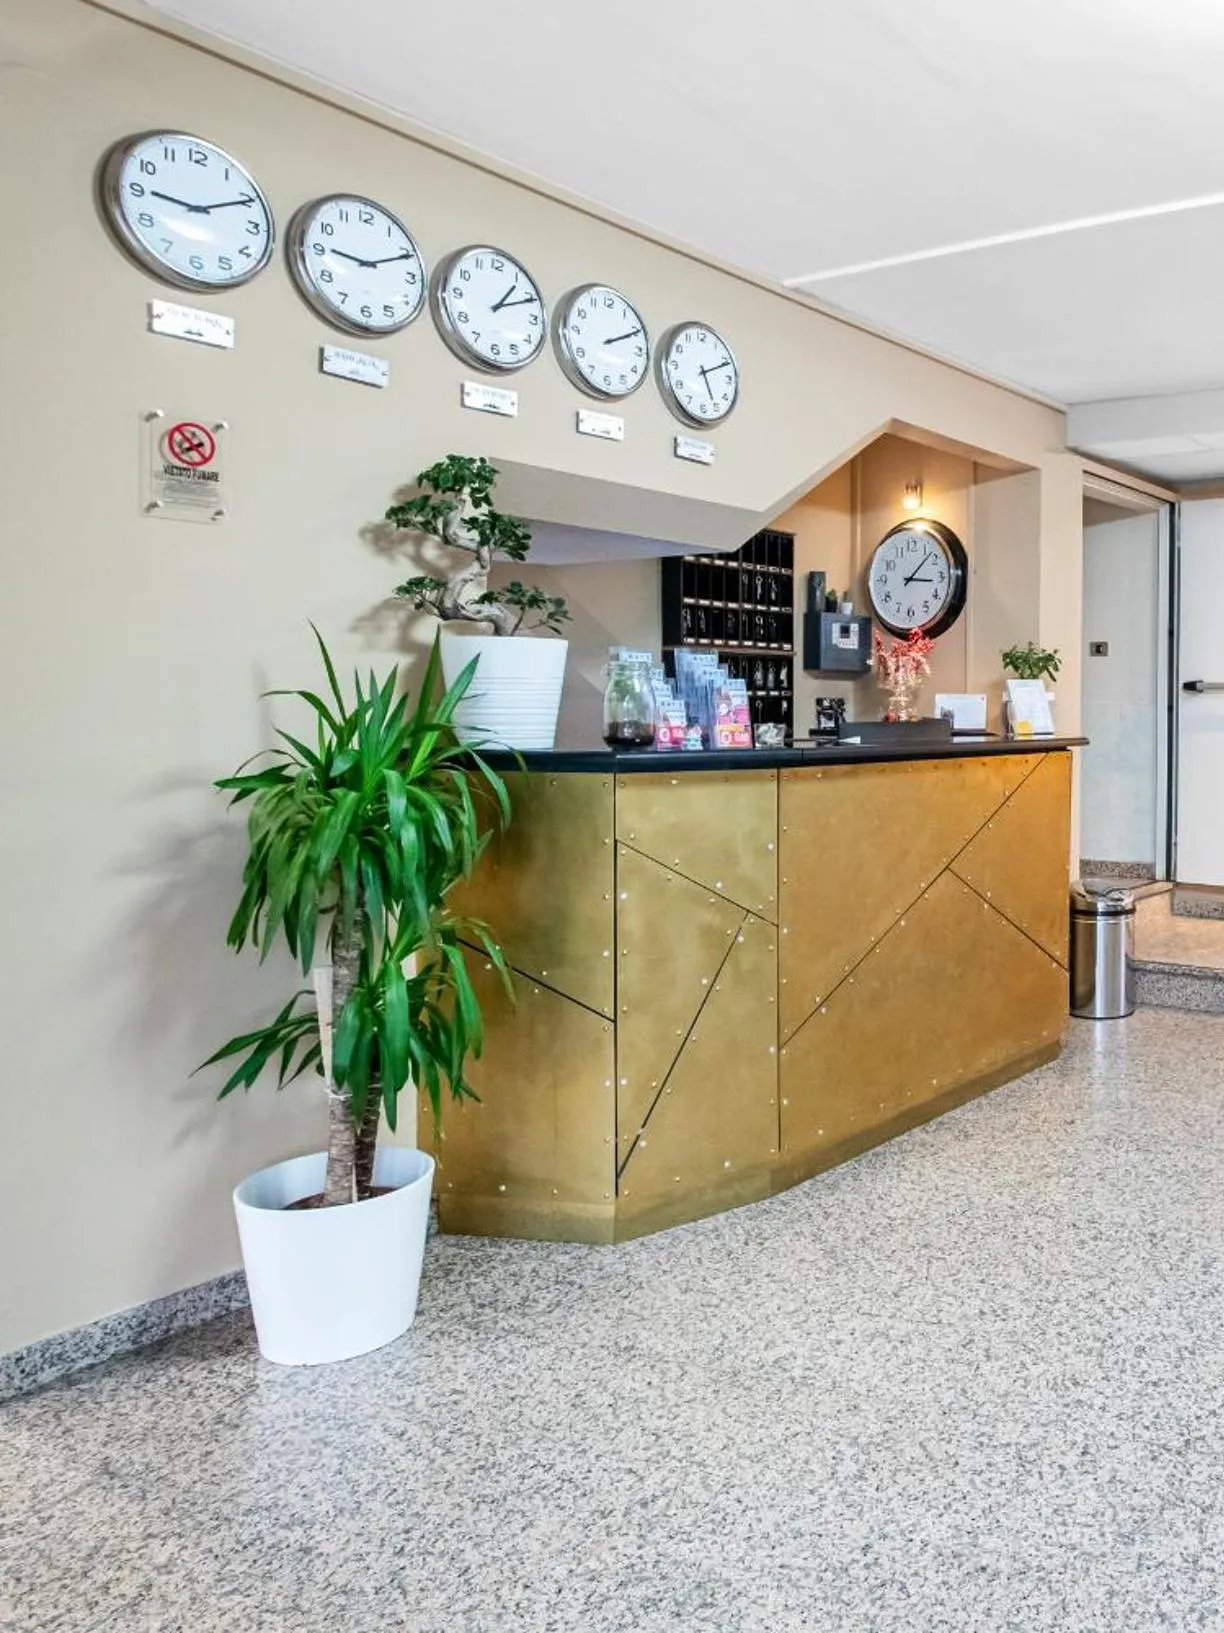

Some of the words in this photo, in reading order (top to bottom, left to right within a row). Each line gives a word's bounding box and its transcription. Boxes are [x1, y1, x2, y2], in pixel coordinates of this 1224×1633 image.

[164, 147, 176, 163] 11
[189, 148, 209, 167] 12
[140, 159, 156, 175] 10
[224, 167, 229, 181] 1
[129, 182, 145, 197] 9
[138, 213, 154, 228] 8
[339, 209, 348, 223] 11
[359, 210, 374, 226] 12
[246, 220, 260, 236] 3
[321, 221, 334, 236] 10
[160, 238, 173, 253] 7
[313, 243, 325, 257] 9
[238, 246, 252, 259] 4
[189, 255, 204, 269] 6
[218, 255, 233, 271] 5
[476, 257, 483, 270] 11
[491, 258, 505, 272] 12
[320, 269, 333, 283] 8
[405, 271, 416, 285] 3
[460, 269, 471, 281] 10
[337, 292, 349, 305] 7
[453, 287, 463, 299] 9
[360, 305, 373, 318] 6
[383, 305, 395, 318] 5
[458, 312, 469, 323] 8
[528, 313, 538, 326] 3
[472, 331, 481, 343] 7
[523, 334, 532, 344] 4
[491, 344, 500, 356] 6
[509, 344, 519, 356] 5
[895, 544, 904, 558] 11
[907, 540, 918, 552] 12
[885, 560, 896, 571] 10
[932, 553, 938, 566] 2
[880, 575, 887, 586] 9
[938, 571, 945, 583] 3
[885, 591, 892, 603] 8
[932, 588, 939, 600] 4
[896, 602, 901, 613] 7
[907, 606, 915, 617] 6
[923, 601, 929, 613] 5
